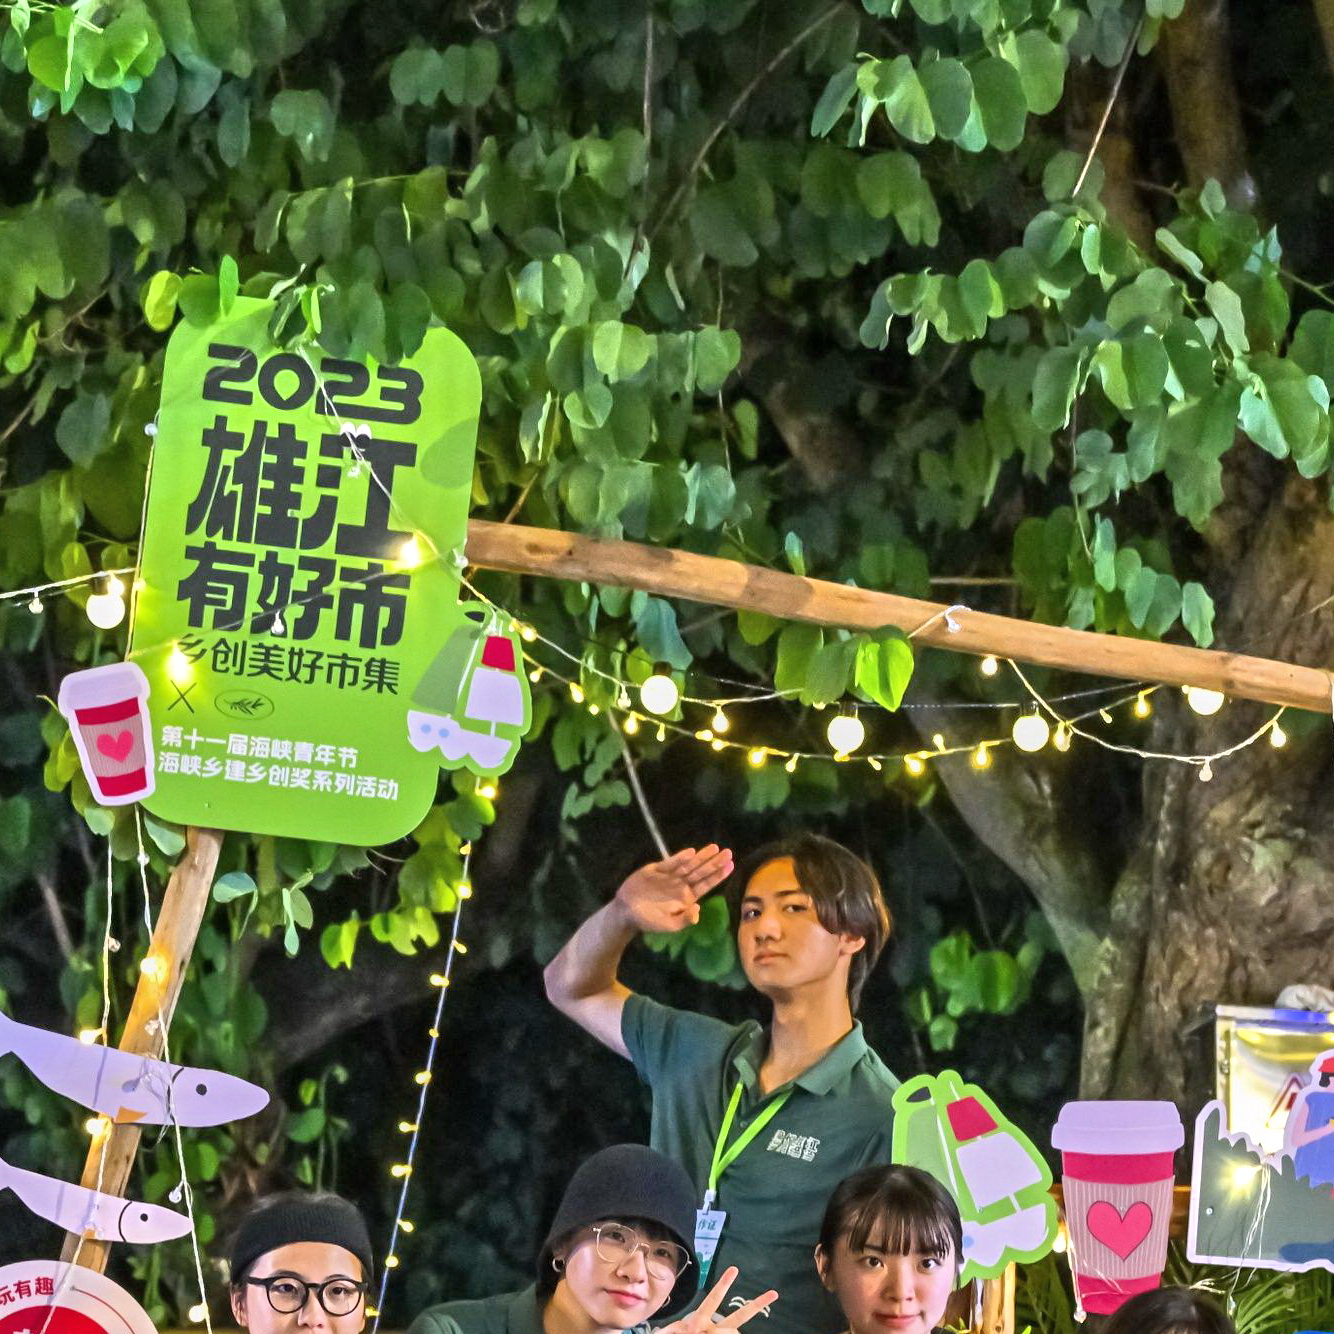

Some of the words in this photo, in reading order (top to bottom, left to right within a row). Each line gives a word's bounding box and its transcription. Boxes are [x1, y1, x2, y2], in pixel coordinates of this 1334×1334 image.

[201, 343, 425, 425] 2023
[184, 415, 417, 562] 雄江
[176, 540, 411, 650] 有好市
[178, 633, 401, 695] 乡创美好市集
[158, 751, 399, 801] 海峡乡建乡创奖系列活动
[162, 725, 359, 769] 第十一届海峡青年节
